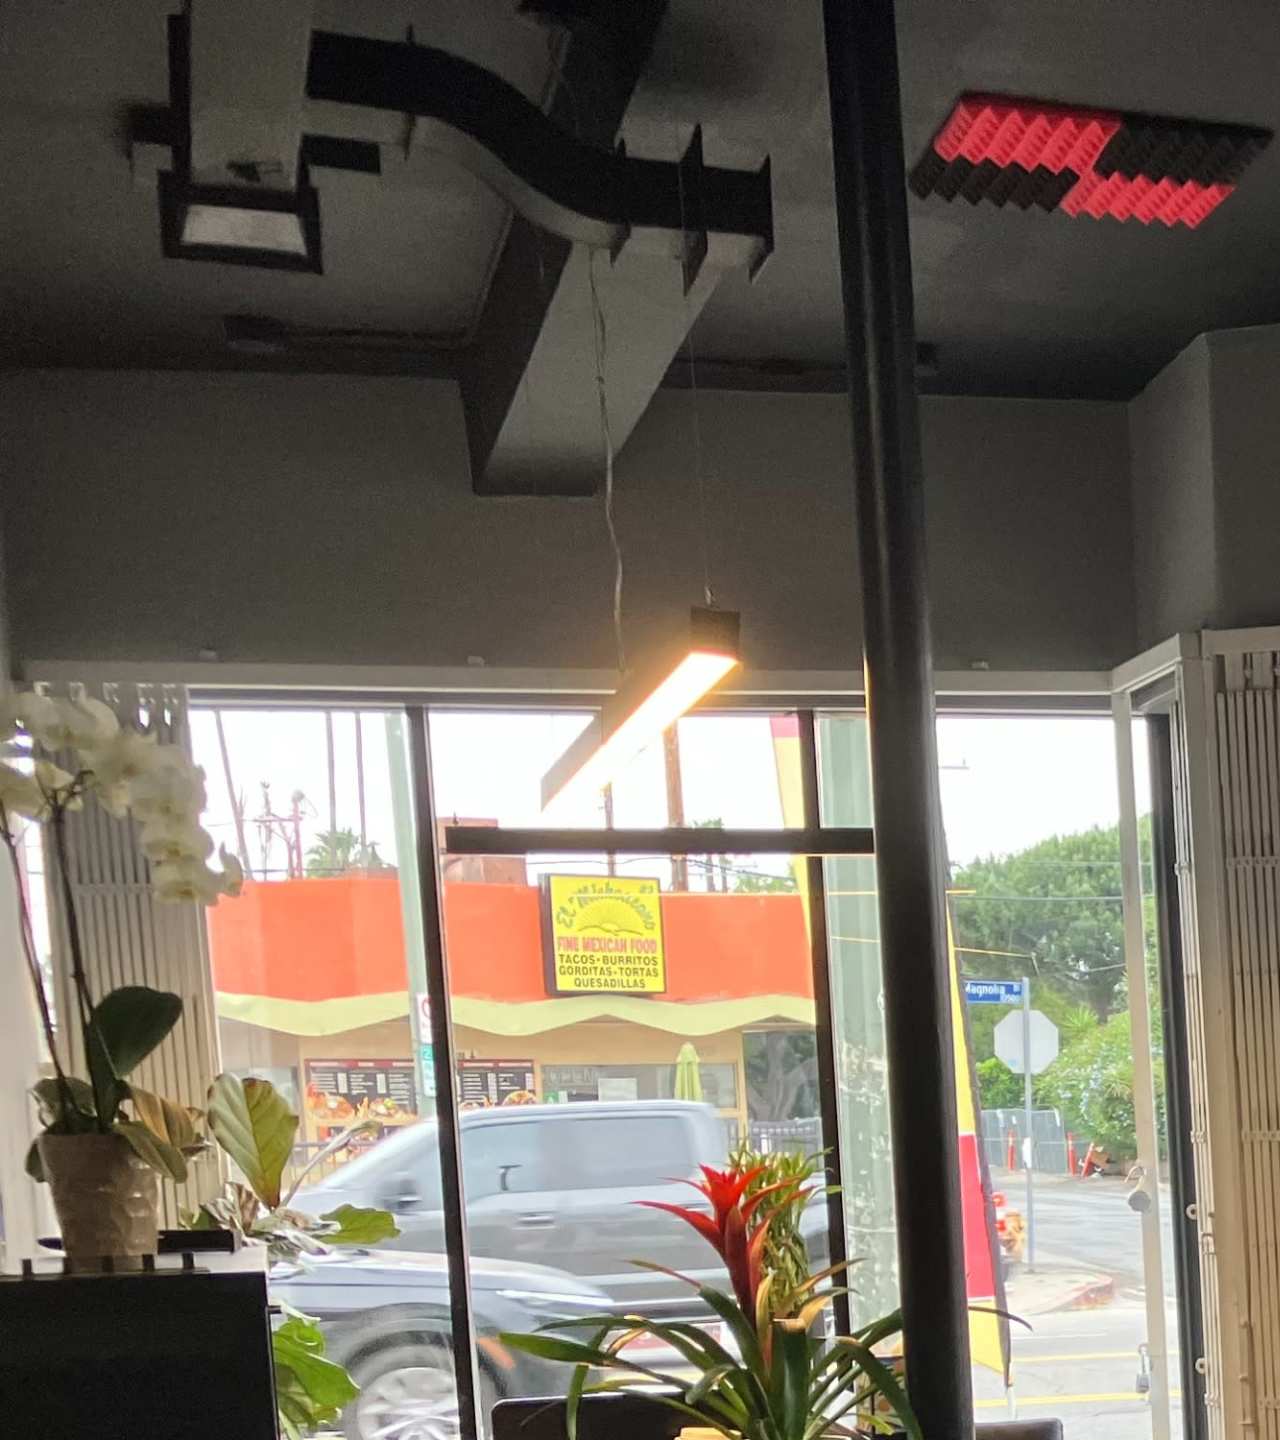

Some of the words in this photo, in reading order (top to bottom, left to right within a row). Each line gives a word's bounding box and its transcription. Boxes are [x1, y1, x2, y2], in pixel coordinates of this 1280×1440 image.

[557, 936, 579, 953] FINE
[582, 937, 627, 954] MEXICAN
[631, 939, 657, 954] FOOD
[558, 954, 596, 964] TACOS
[602, 955, 658, 966] BURRITOS
[558, 966, 613, 977] GORDITAS
[618, 967, 659, 977] TORTAS
[574, 977, 646, 989] QUESADILLAS
